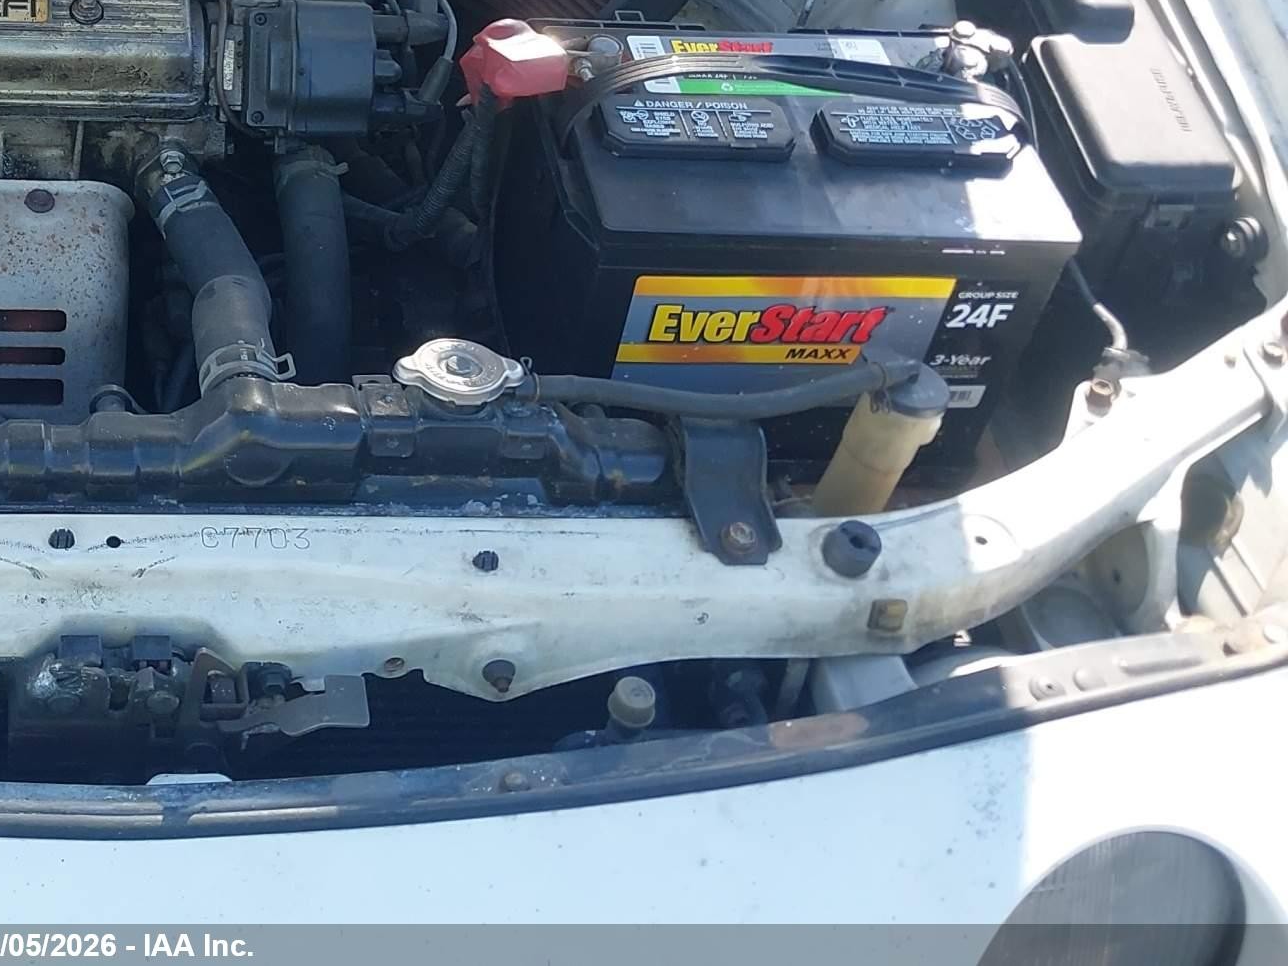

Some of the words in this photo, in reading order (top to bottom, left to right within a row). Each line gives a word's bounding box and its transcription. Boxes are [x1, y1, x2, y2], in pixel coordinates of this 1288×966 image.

[646, 100, 693, 110] DANGER
[704, 101, 748, 111] POISON
[958, 291, 995, 299] GROUP
[996, 291, 1019, 299] SIZE
[945, 303, 1015, 329] 24F
[647, 303, 889, 345] EverStart
[784, 348, 852, 360] MAXX
[929, 354, 992, 366] 3-Year
